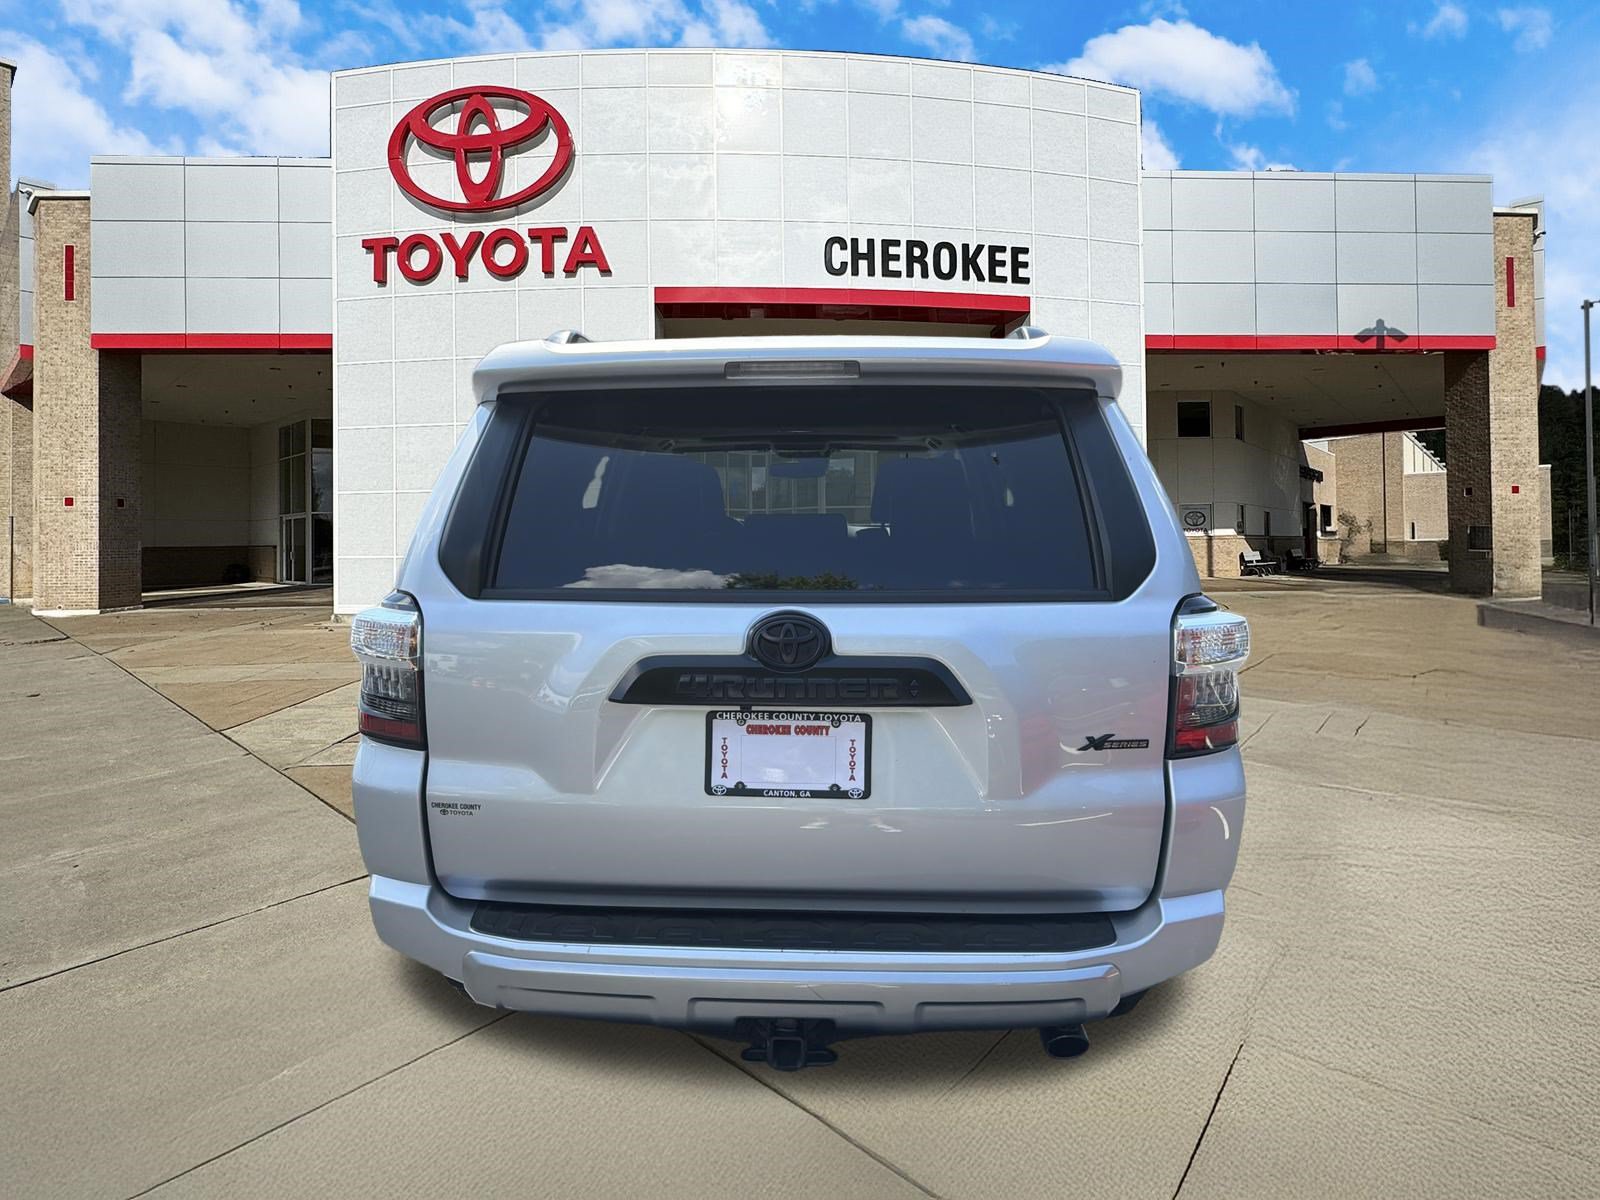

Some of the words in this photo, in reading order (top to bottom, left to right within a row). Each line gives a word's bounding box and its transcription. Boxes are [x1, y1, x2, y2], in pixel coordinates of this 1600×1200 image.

[362, 226, 612, 284] TOYOTA
[824, 236, 1030, 284] CHEROKEE
[716, 711, 769, 721] CHEROKEE
[772, 712, 815, 722] COUNTY
[819, 714, 862, 723] TOYOTA
[746, 724, 792, 736] CHEROKEE
[794, 725, 831, 736] COUNTY
[763, 789, 798, 799] CANTON,
[799, 790, 811, 798] GA
